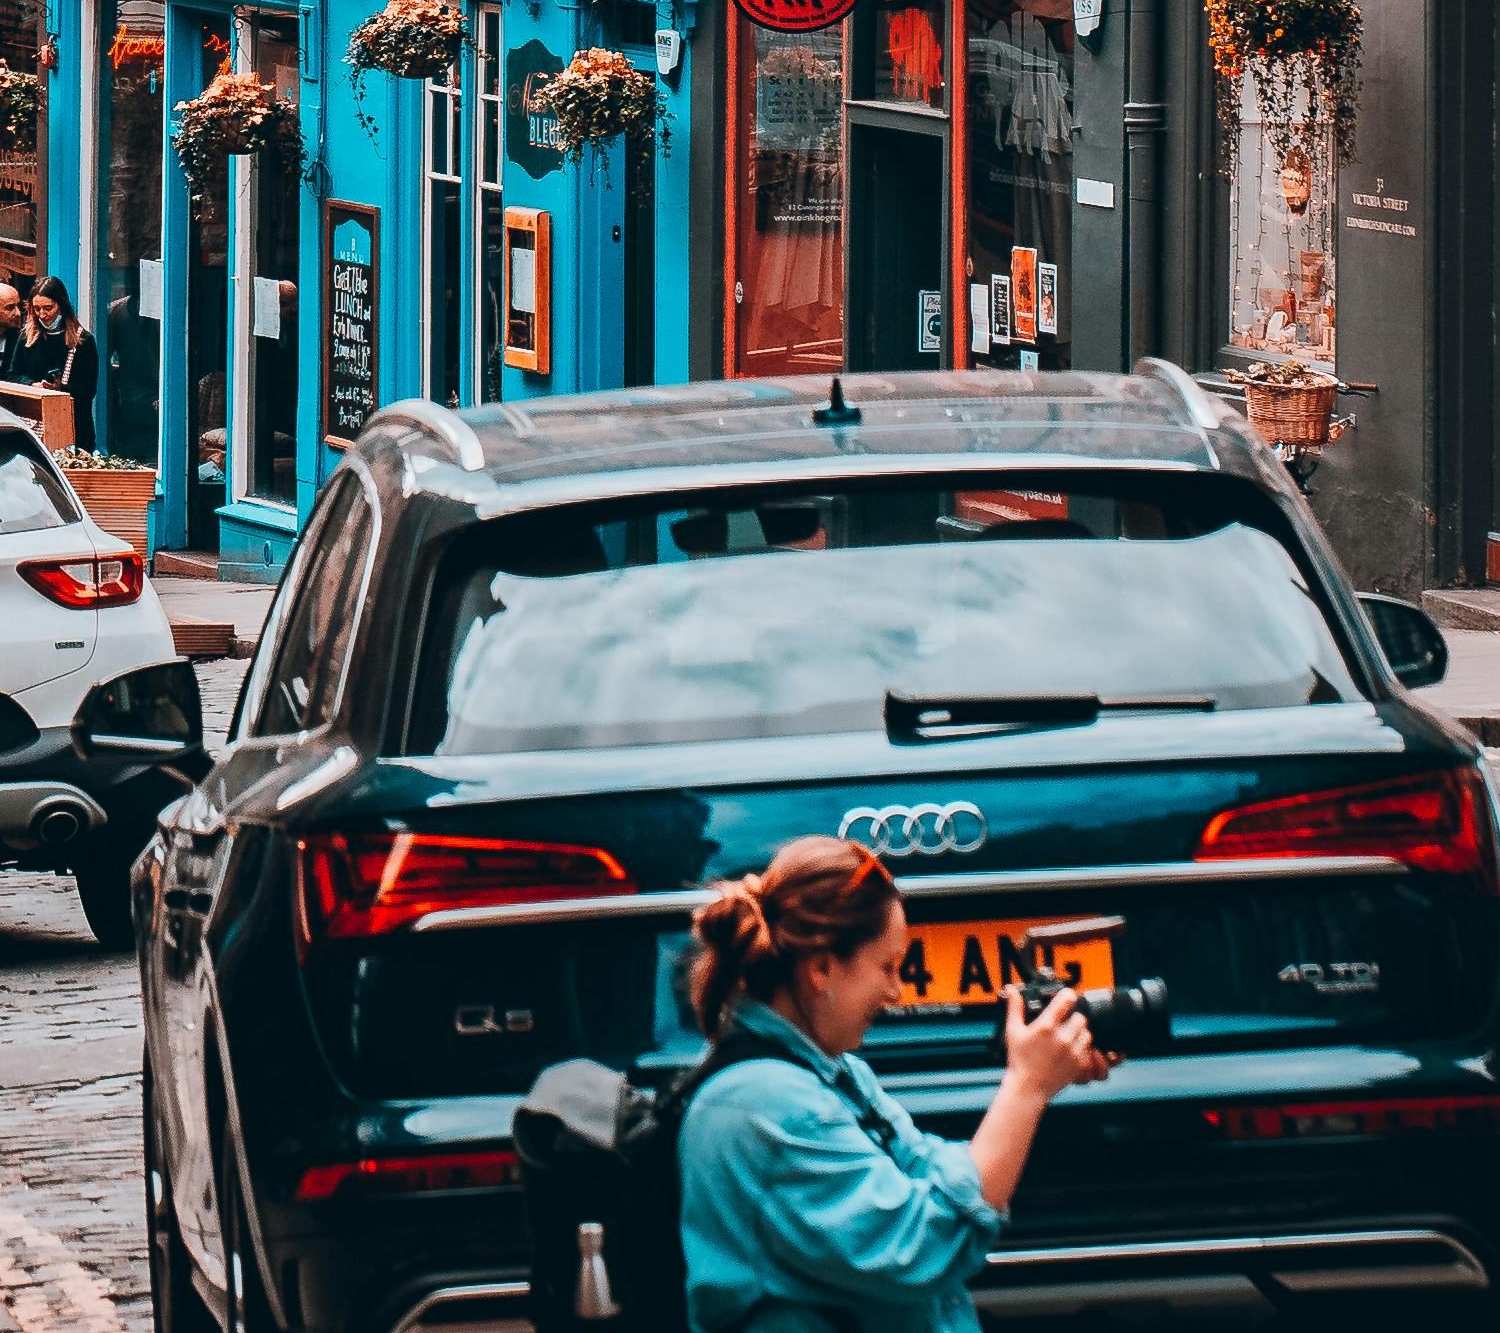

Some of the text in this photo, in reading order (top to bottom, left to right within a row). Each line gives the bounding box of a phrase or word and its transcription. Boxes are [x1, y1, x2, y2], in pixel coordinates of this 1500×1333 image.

[1352, 192, 1409, 212] VICTORIA STREET
[335, 291, 363, 320] LUNCH
